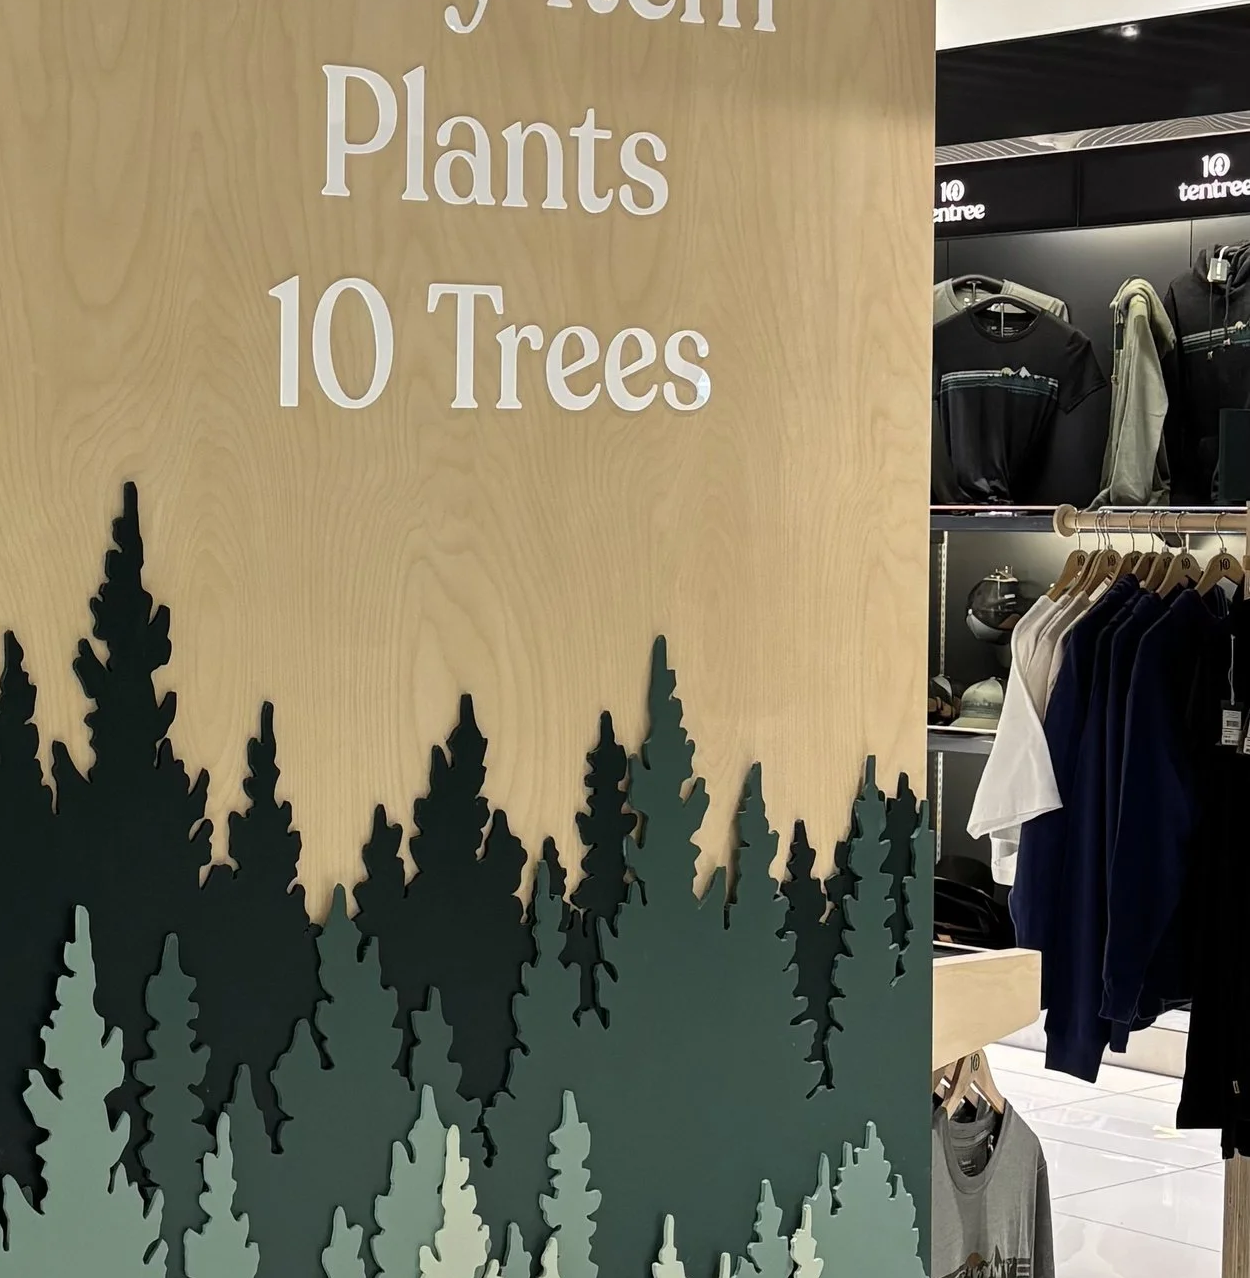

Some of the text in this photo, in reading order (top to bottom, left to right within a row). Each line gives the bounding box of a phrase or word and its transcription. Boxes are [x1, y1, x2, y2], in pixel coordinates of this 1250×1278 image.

[321, 64, 669, 216] Plants
[1201, 152, 1231, 178] 10
[1178, 179, 1250, 202] tentree
[933, 204, 986, 223] entree
[268, 275, 712, 412] 10 Trees
